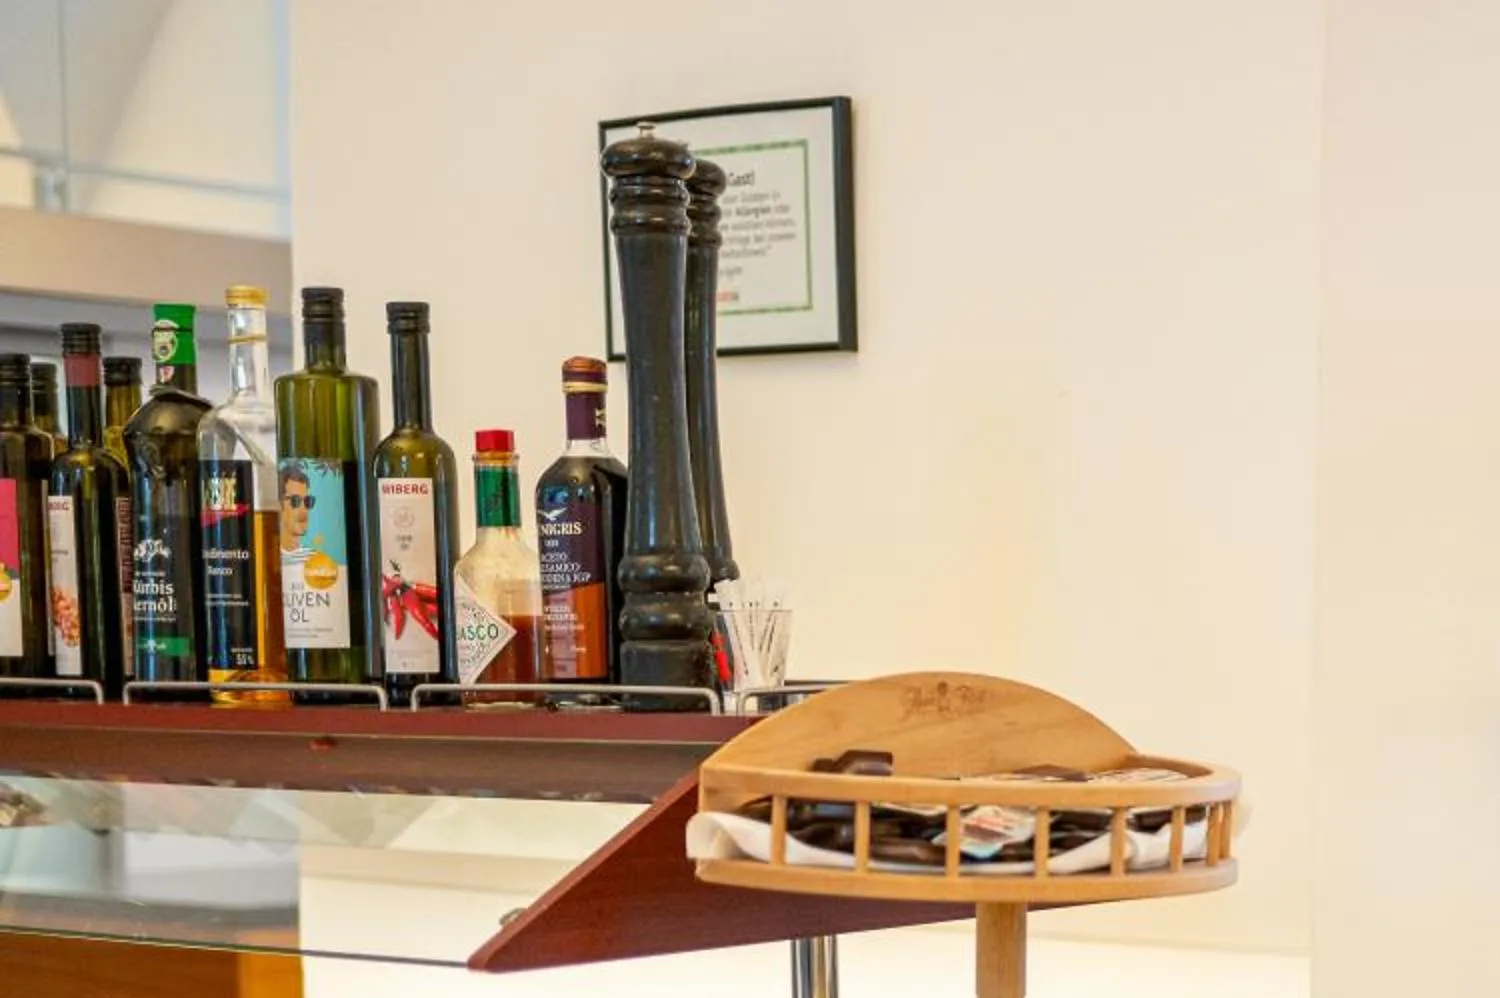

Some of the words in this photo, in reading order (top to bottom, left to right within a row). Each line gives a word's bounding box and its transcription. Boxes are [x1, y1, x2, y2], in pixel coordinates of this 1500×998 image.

[383, 484, 429, 494] WIBERG
[133, 579, 175, 595] ürbis
[133, 597, 173, 612] ernöl
[460, 623, 499, 640] ASCO
